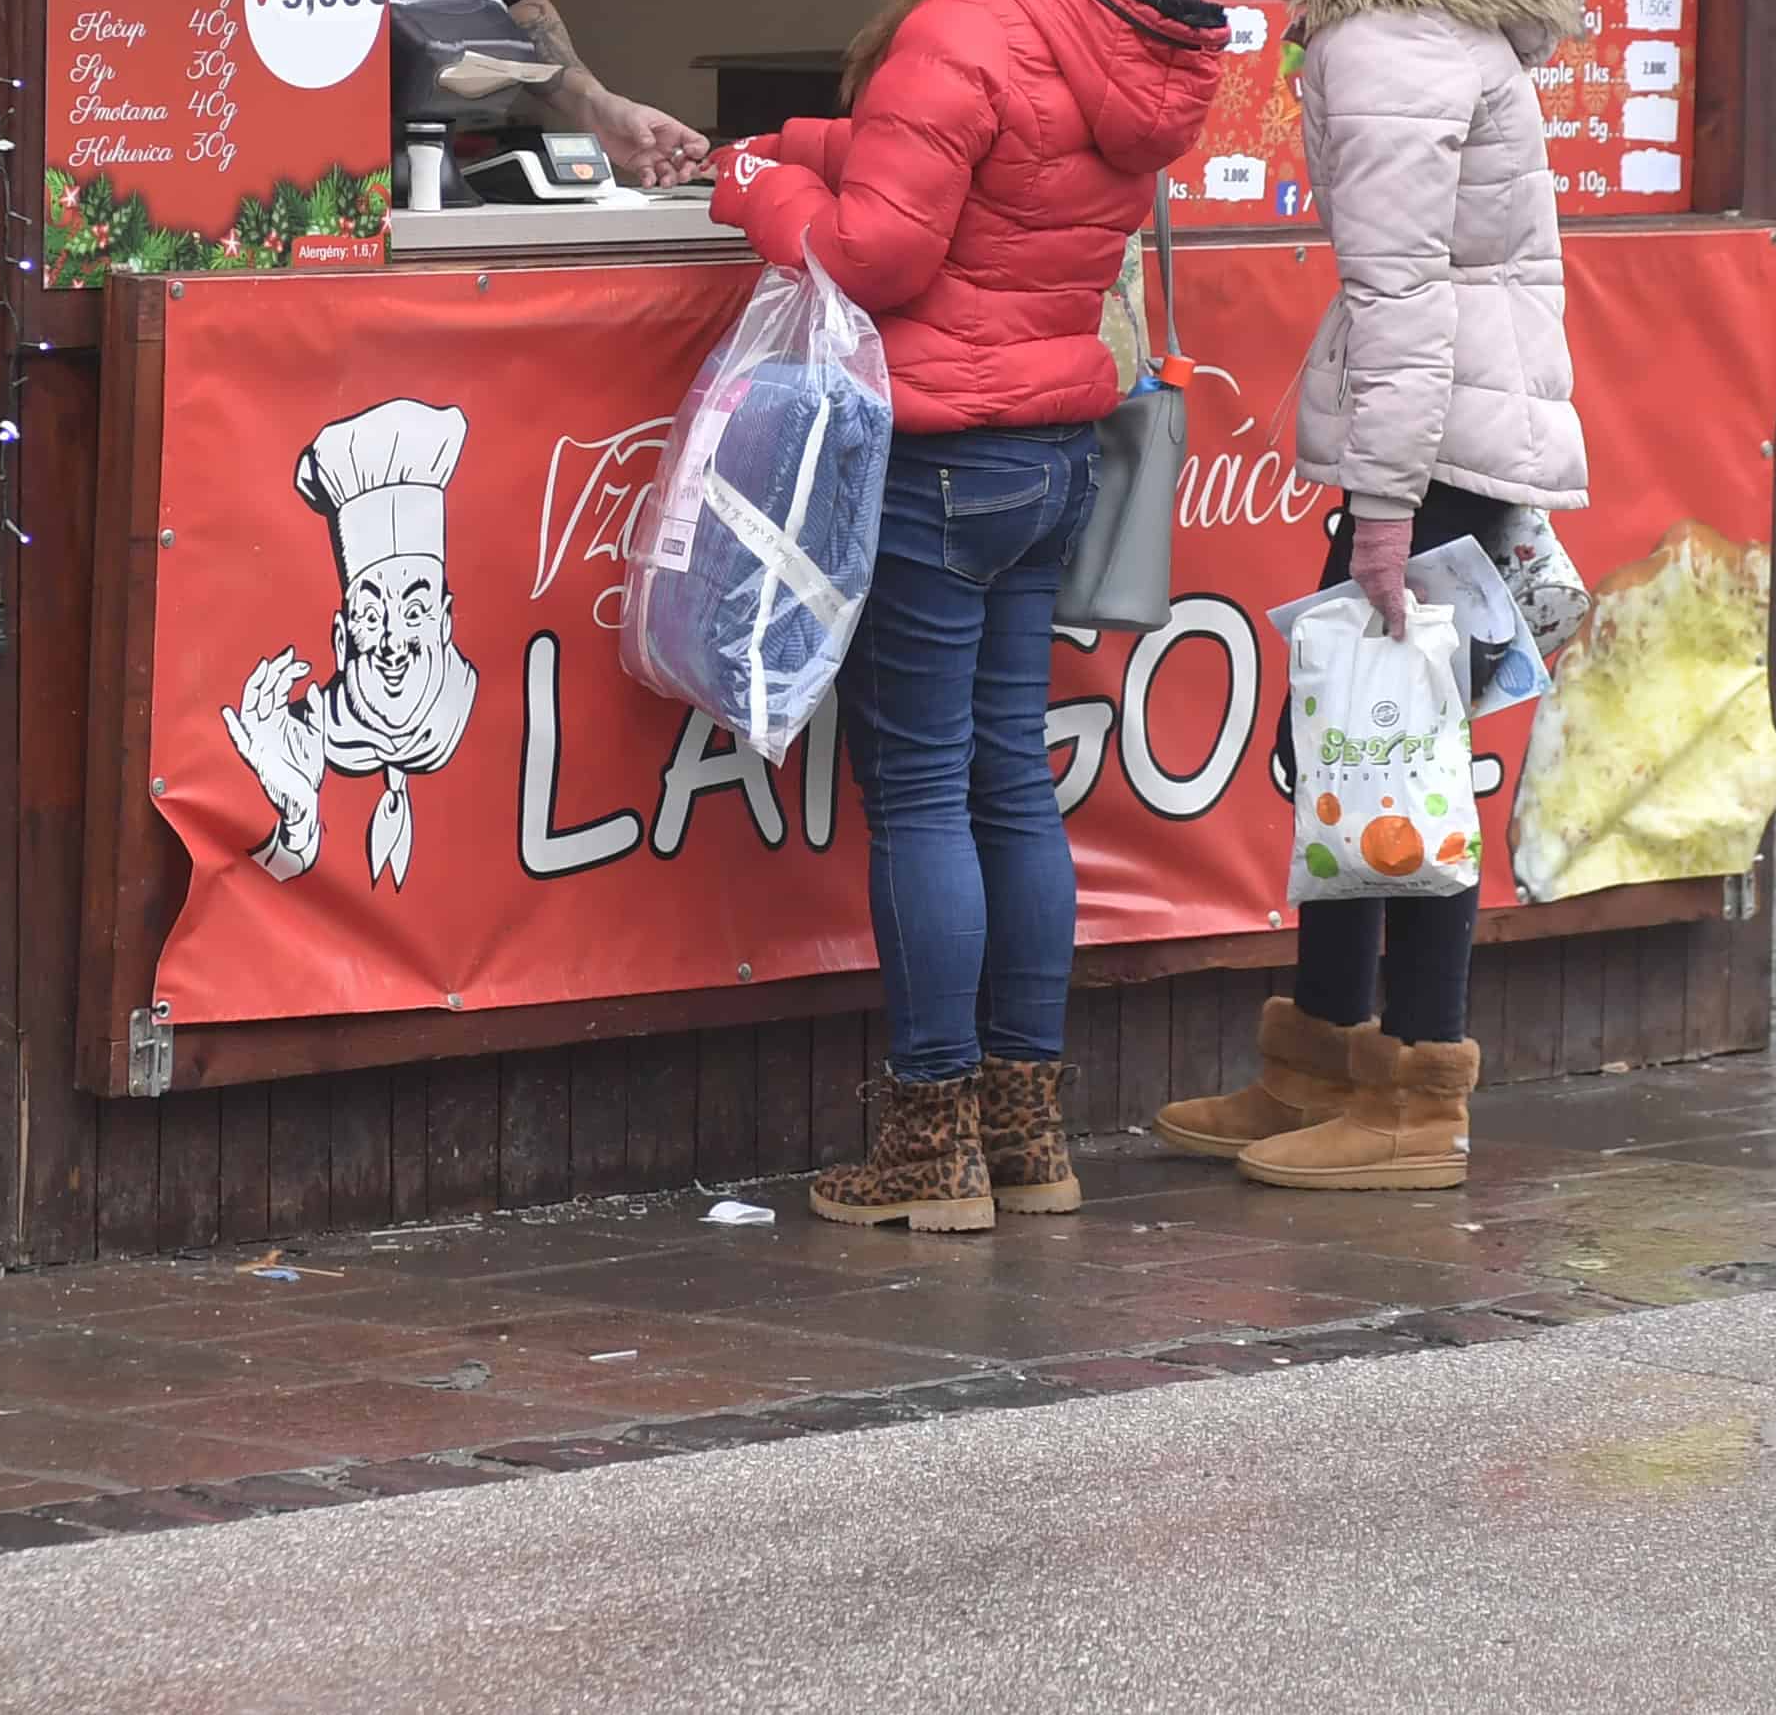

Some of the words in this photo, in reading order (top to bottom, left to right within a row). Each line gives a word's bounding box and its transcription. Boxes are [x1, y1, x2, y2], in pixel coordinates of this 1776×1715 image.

[70, 11, 147, 47] Kečup
[188, 10, 239, 49] 40g
[186, 50, 239, 91] 30g
[69, 95, 169, 125] Smotana
[188, 91, 239, 131] 40g
[1542, 115, 1581, 138] ukor
[68, 135, 174, 167] Kukurica
[186, 131, 238, 172] 30g
[298, 244, 349, 261] Alergény:
